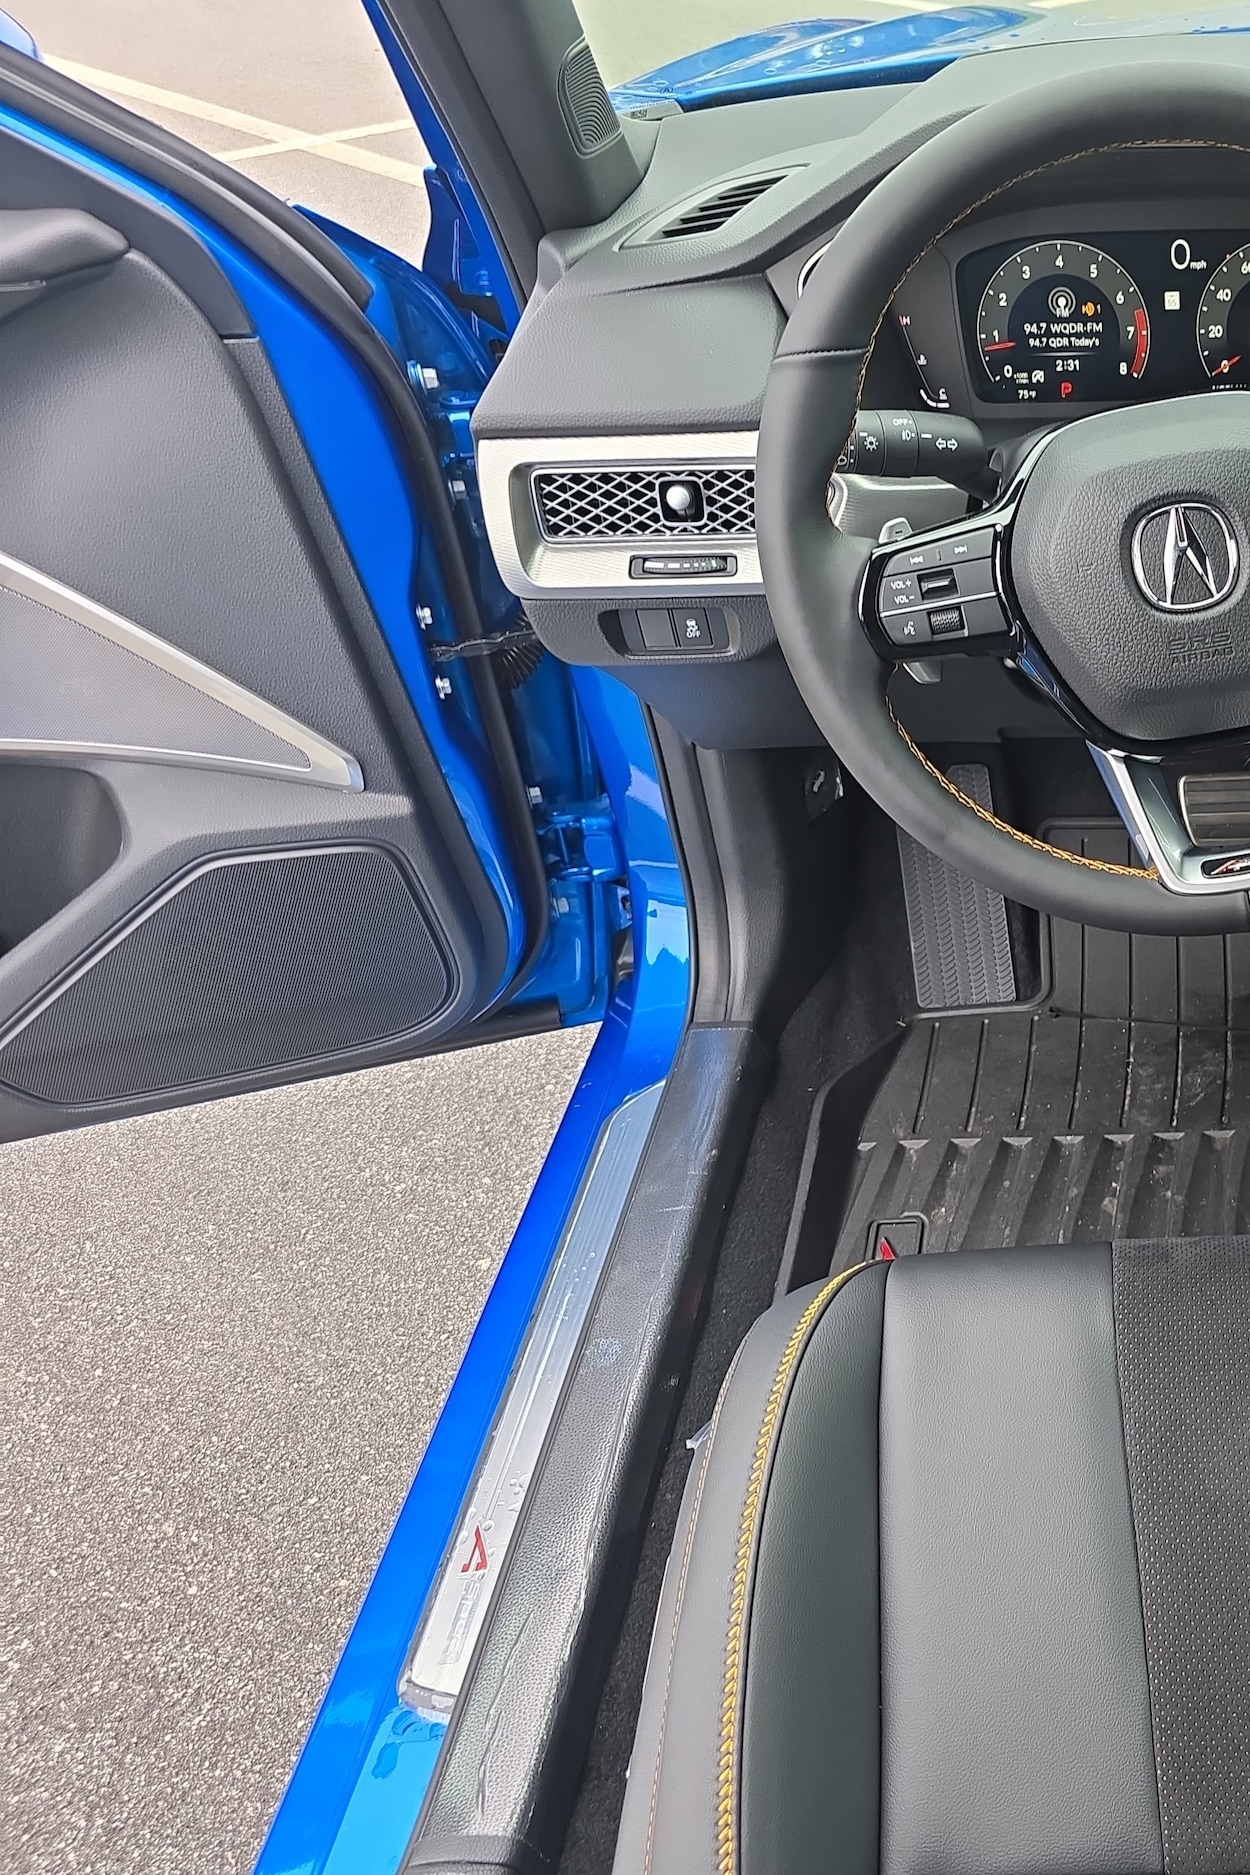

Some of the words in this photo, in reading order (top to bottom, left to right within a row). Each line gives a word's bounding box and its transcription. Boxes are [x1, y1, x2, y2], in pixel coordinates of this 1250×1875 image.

[1170, 239, 1191, 270] 0
[1190, 260, 1207, 270] mph
[1055, 255, 1064, 268] 4
[1022, 266, 1031, 279] 3
[1090, 265, 1098, 278] 5
[1000, 293, 1007, 306] 2
[1116, 291, 1124, 304] 6
[1217, 289, 1231, 301] 40
[1056, 309, 1069, 317] FM
[1024, 323, 1046, 335] 94.7
[1127, 327, 1135, 340] 7
[1209, 325, 1223, 338] 20
[993, 330, 999, 342] 1
[1029, 338, 1046, 346] 94.7
[1049, 338, 1069, 346] QDR
[1070, 337, 1099, 347] Today's
[1004, 365, 1012, 378] 0
[1056, 359, 1080, 371] 2:31
[1120, 362, 1127, 375] 8
[1221, 360, 1229, 373] 0
[1061, 382, 1072, 398] P
